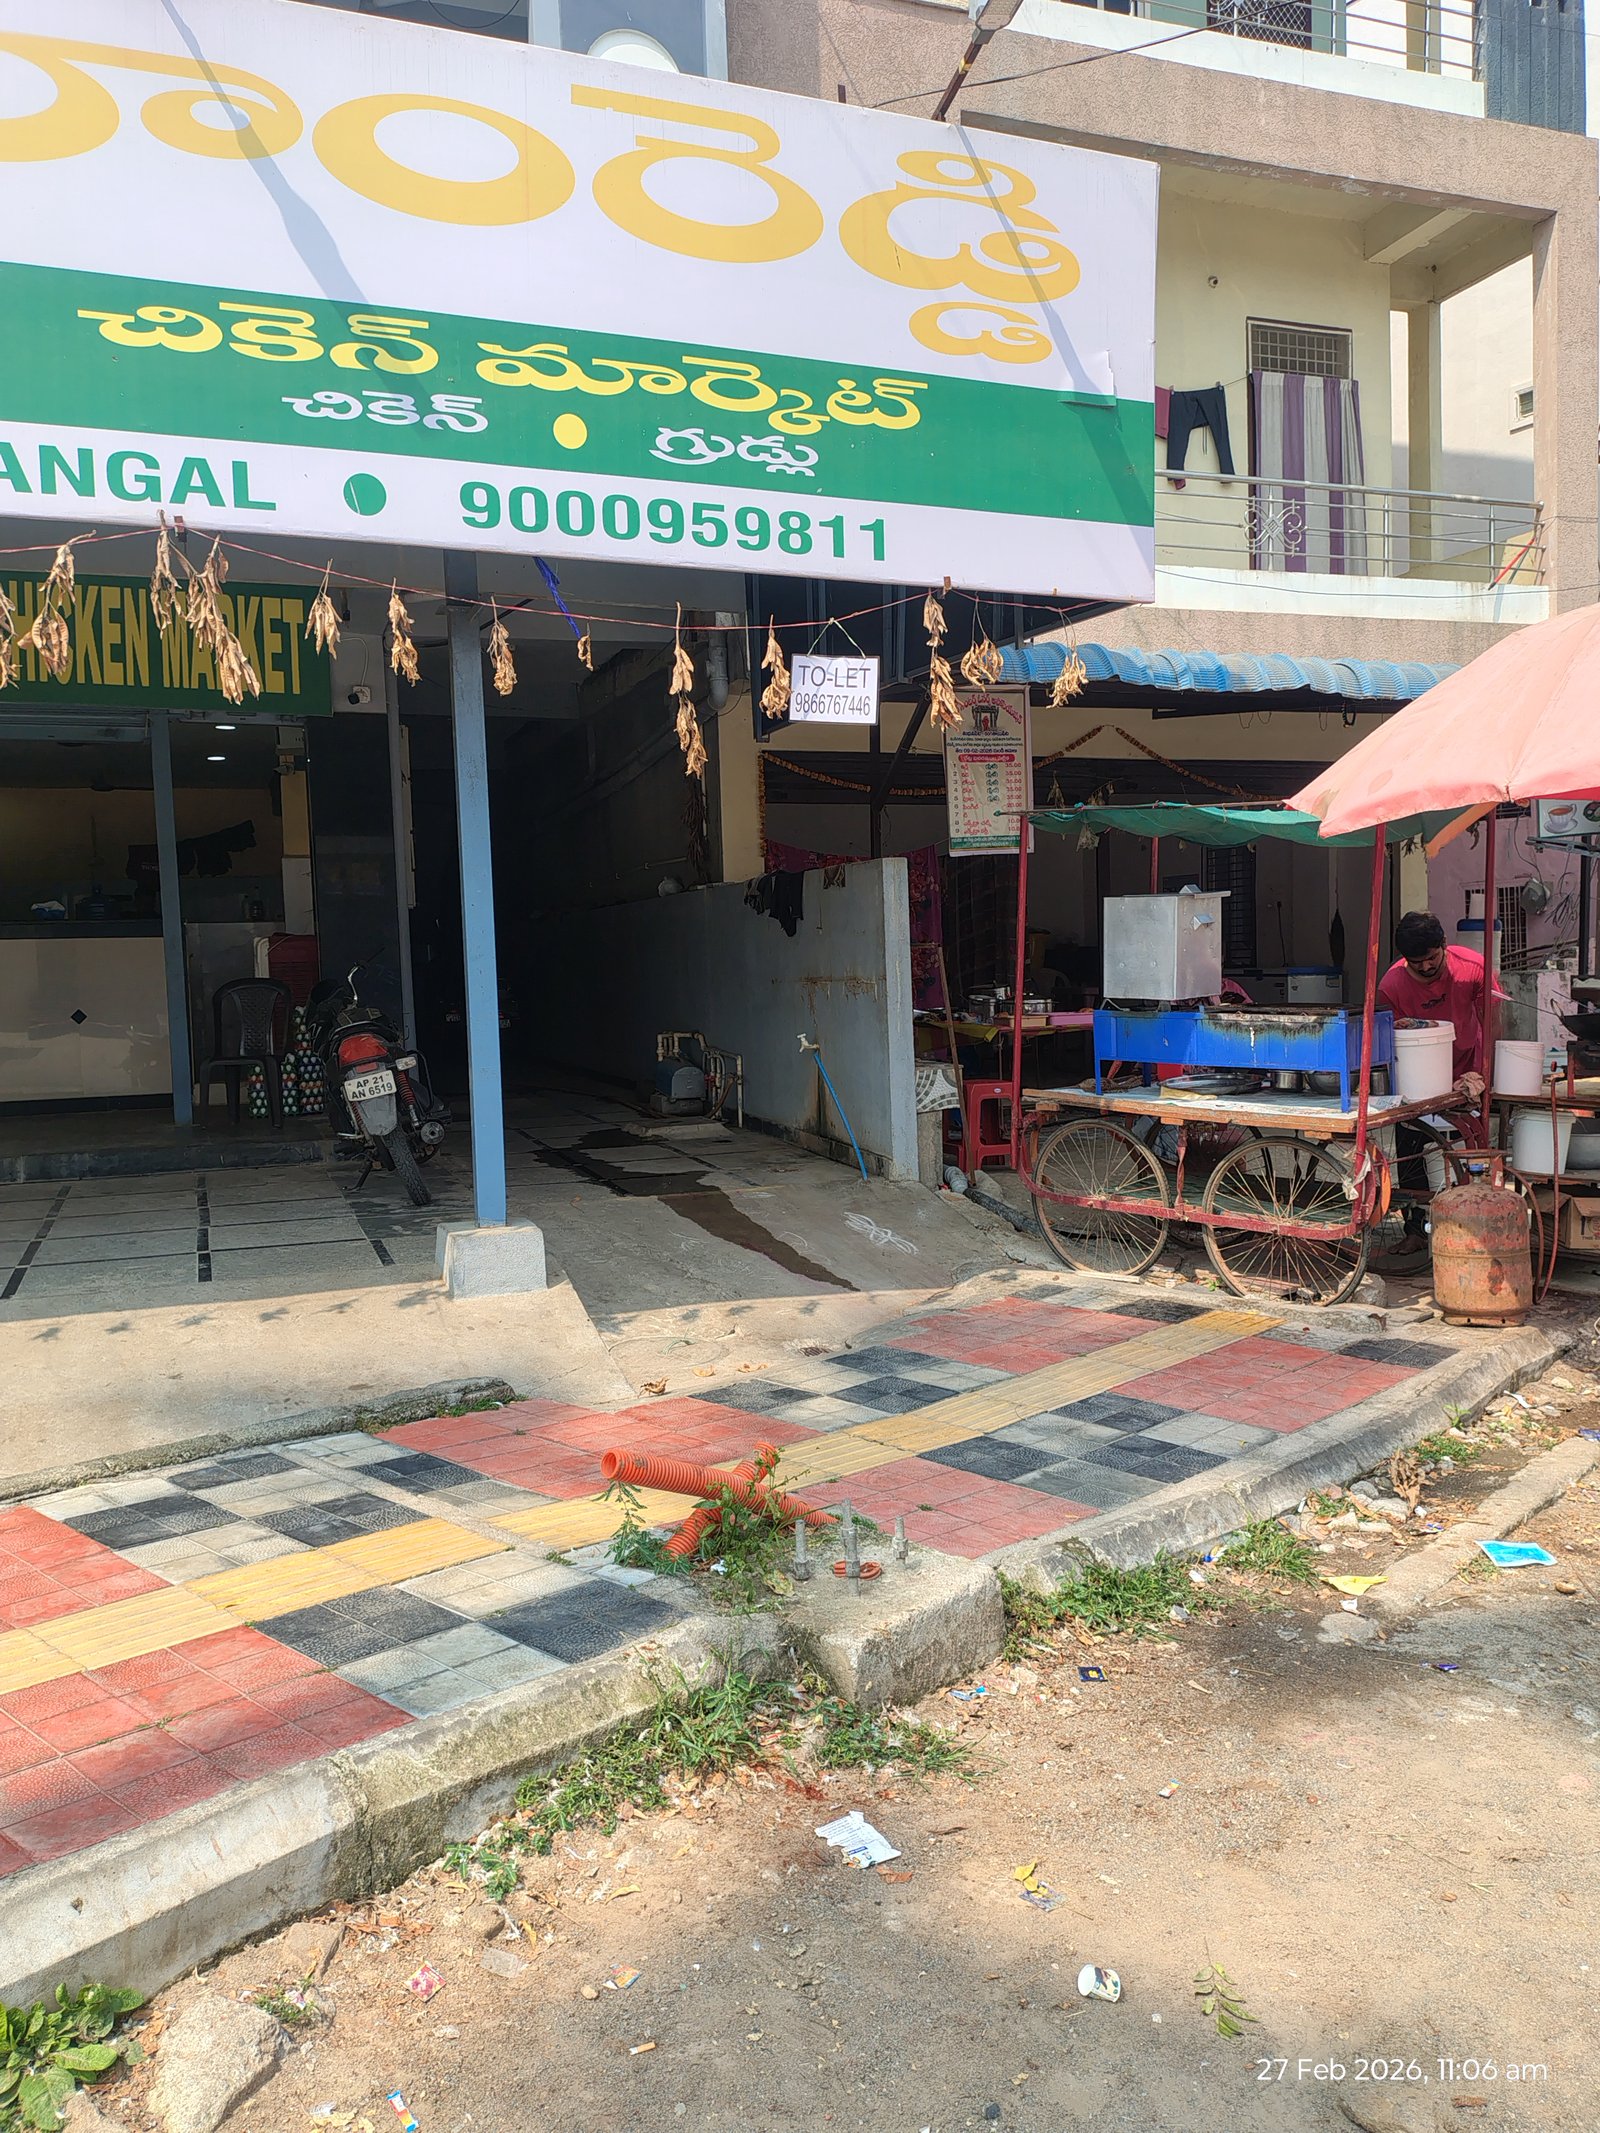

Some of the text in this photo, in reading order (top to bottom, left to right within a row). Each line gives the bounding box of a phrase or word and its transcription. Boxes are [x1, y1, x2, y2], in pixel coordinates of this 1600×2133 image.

[77, 301, 929, 435] చికెన్ మార్కెట్
[281, 390, 819, 477] చికెన్ గ్రుడ్లు
[459, 480, 886, 562] 9000959811
[798, 665, 871, 688] TO-LET
[795, 692, 871, 716] 9866767446
[351, 1082, 393, 1099] AN 6519
[356, 1075, 384, 1088] AP 21
